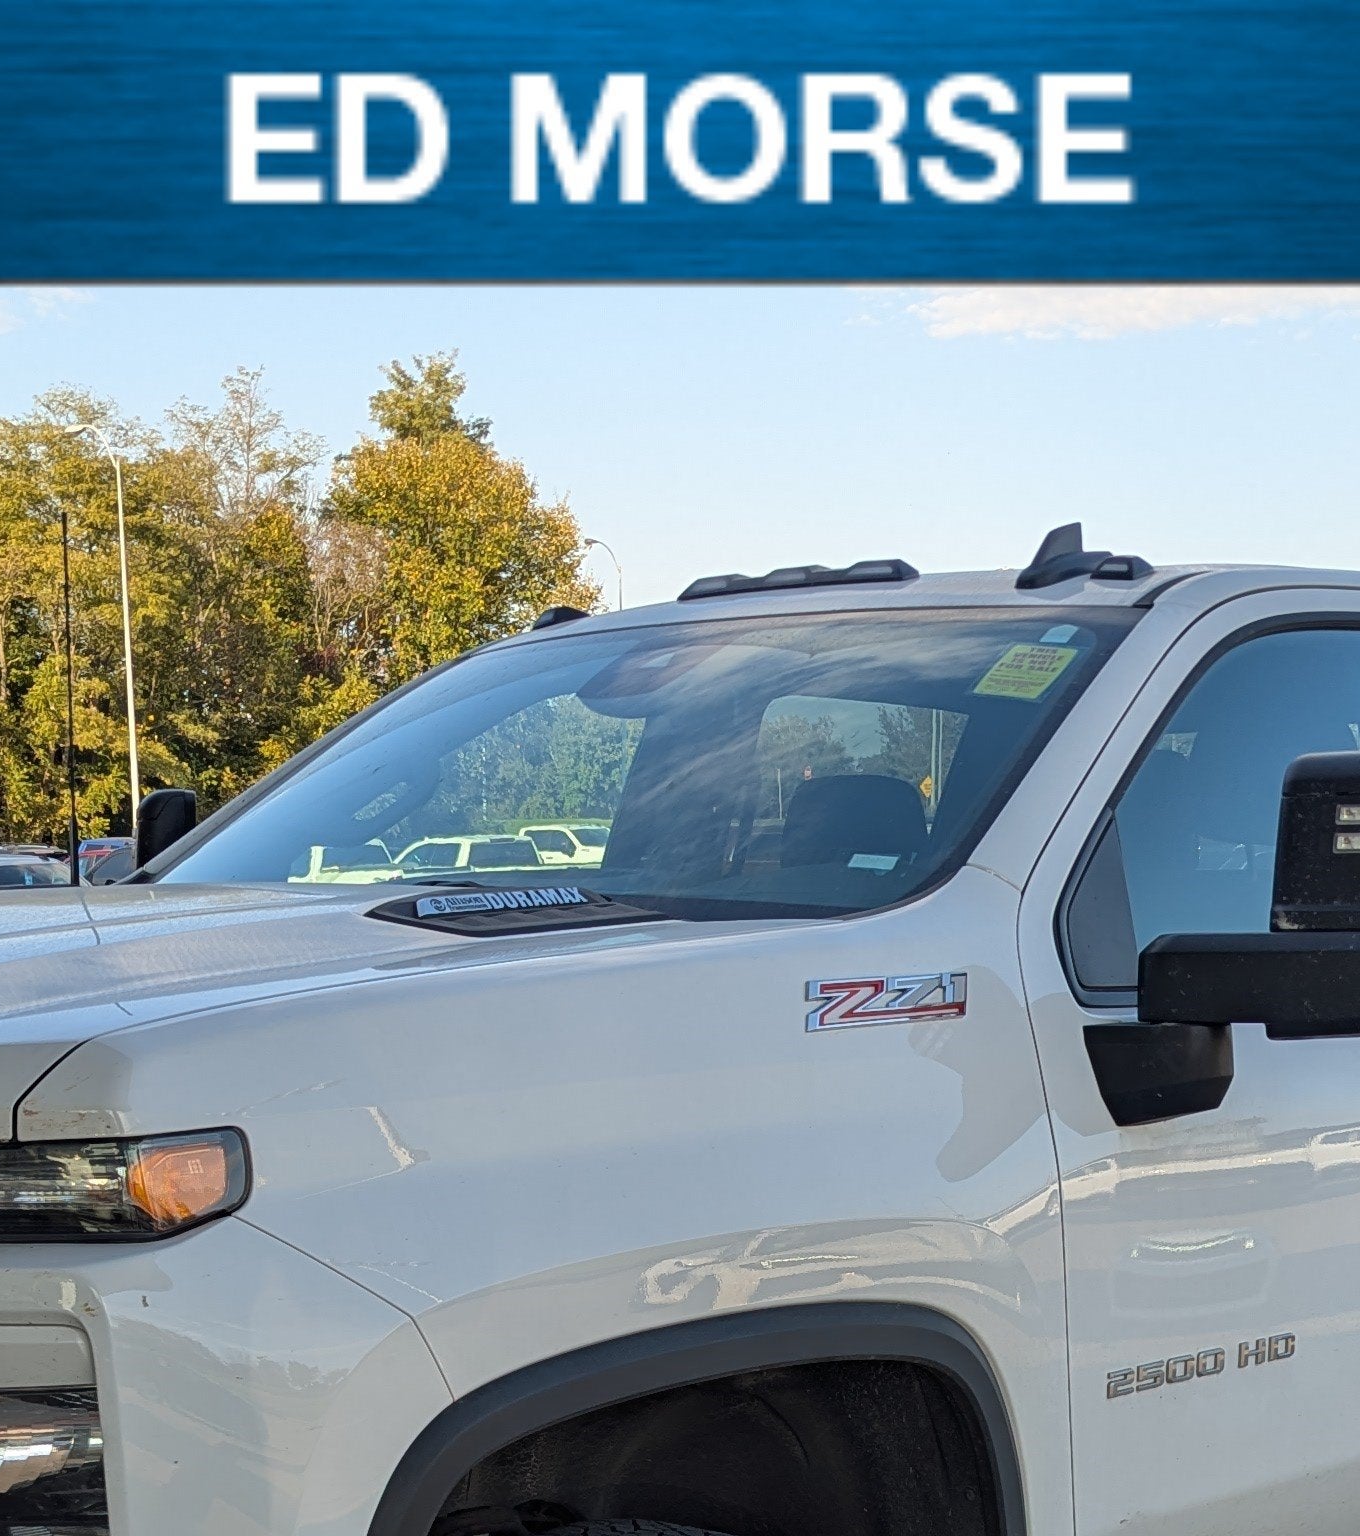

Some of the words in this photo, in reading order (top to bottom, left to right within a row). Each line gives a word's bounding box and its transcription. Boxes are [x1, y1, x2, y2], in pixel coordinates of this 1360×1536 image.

[490, 886, 588, 910] DURAMAX
[804, 972, 968, 1034] Z71
[1106, 1347, 1226, 1400] 2500
[1237, 1332, 1296, 1369] HD
